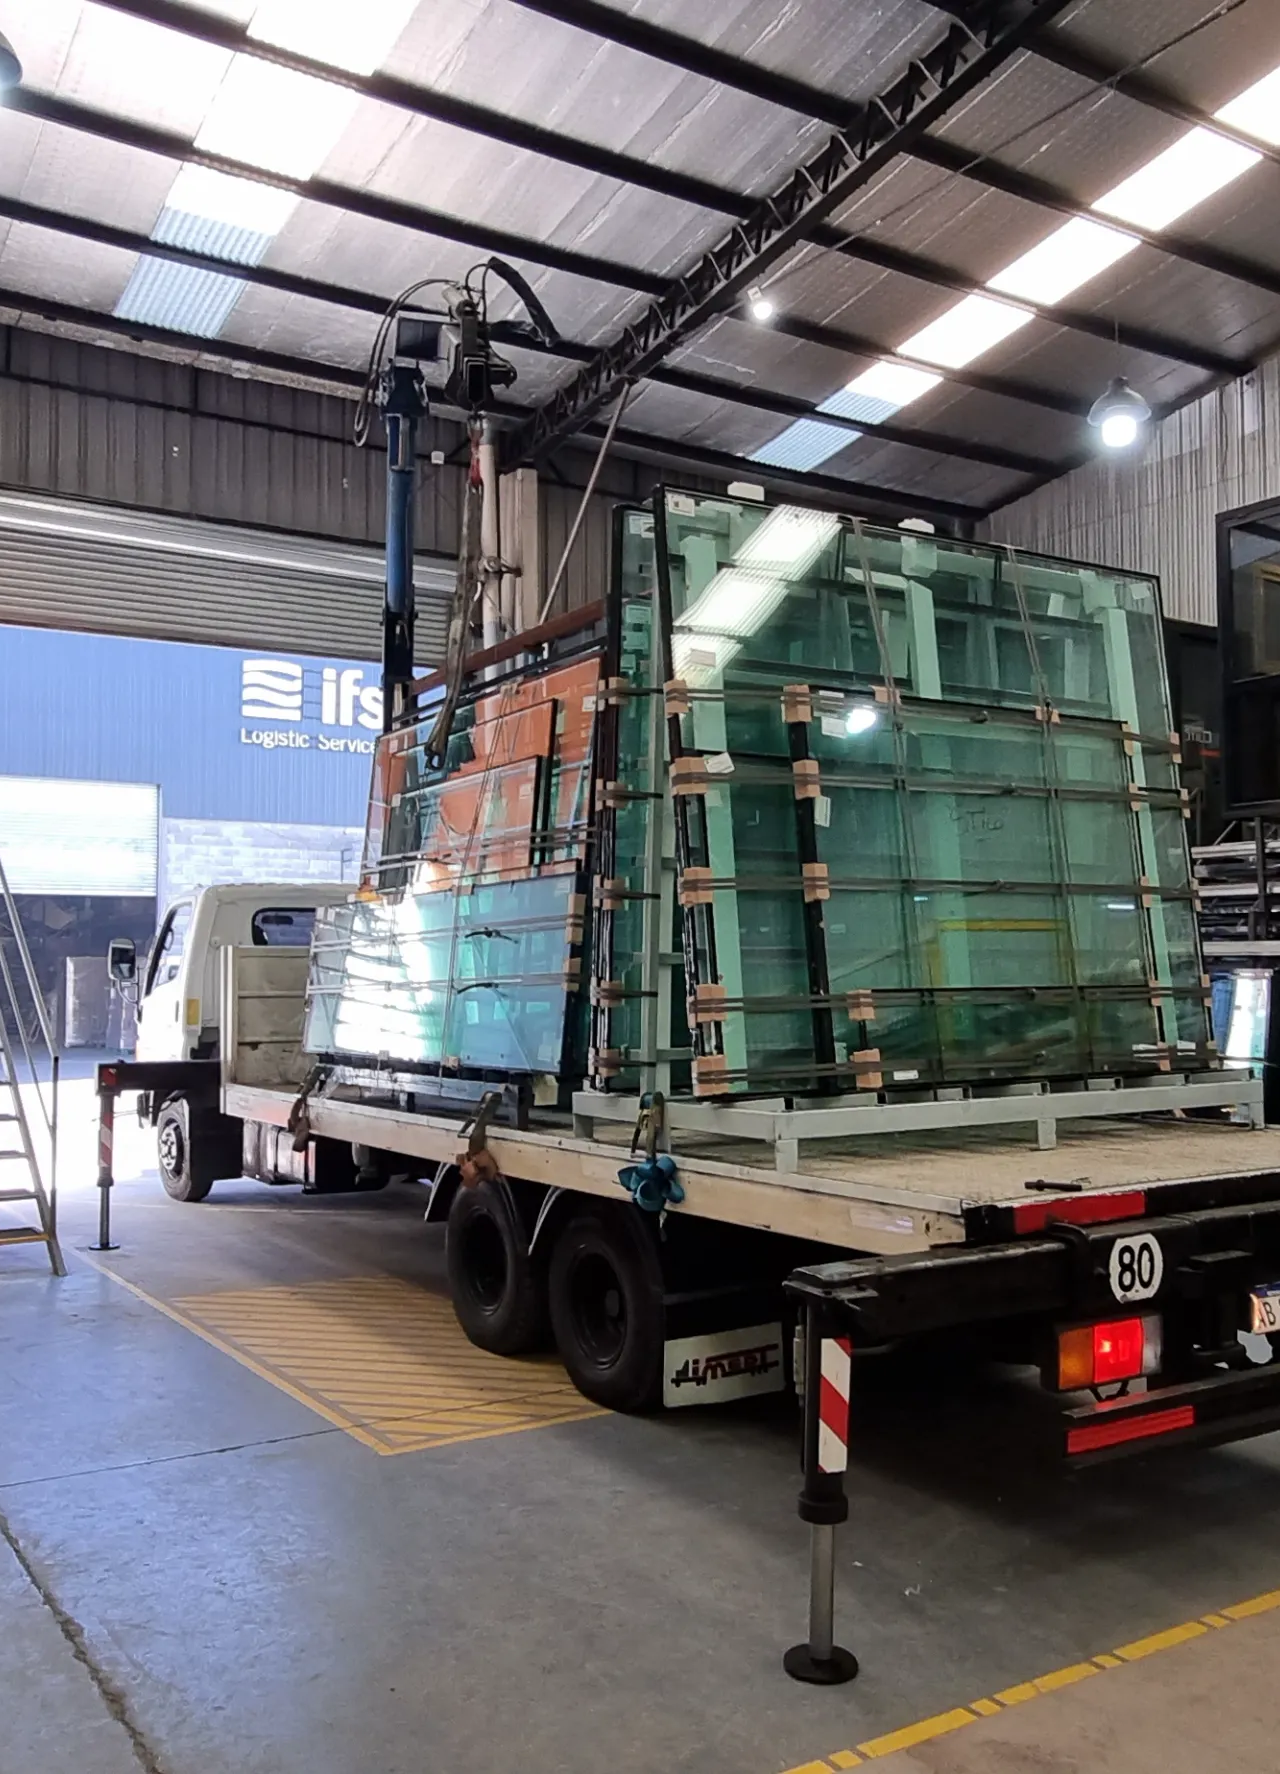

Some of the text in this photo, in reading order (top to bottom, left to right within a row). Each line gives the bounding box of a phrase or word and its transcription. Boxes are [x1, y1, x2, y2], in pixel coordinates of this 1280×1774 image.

[322, 668, 383, 729] ifs
[241, 728, 310, 748] Logistic
[1118, 1242, 1155, 1293] 80
